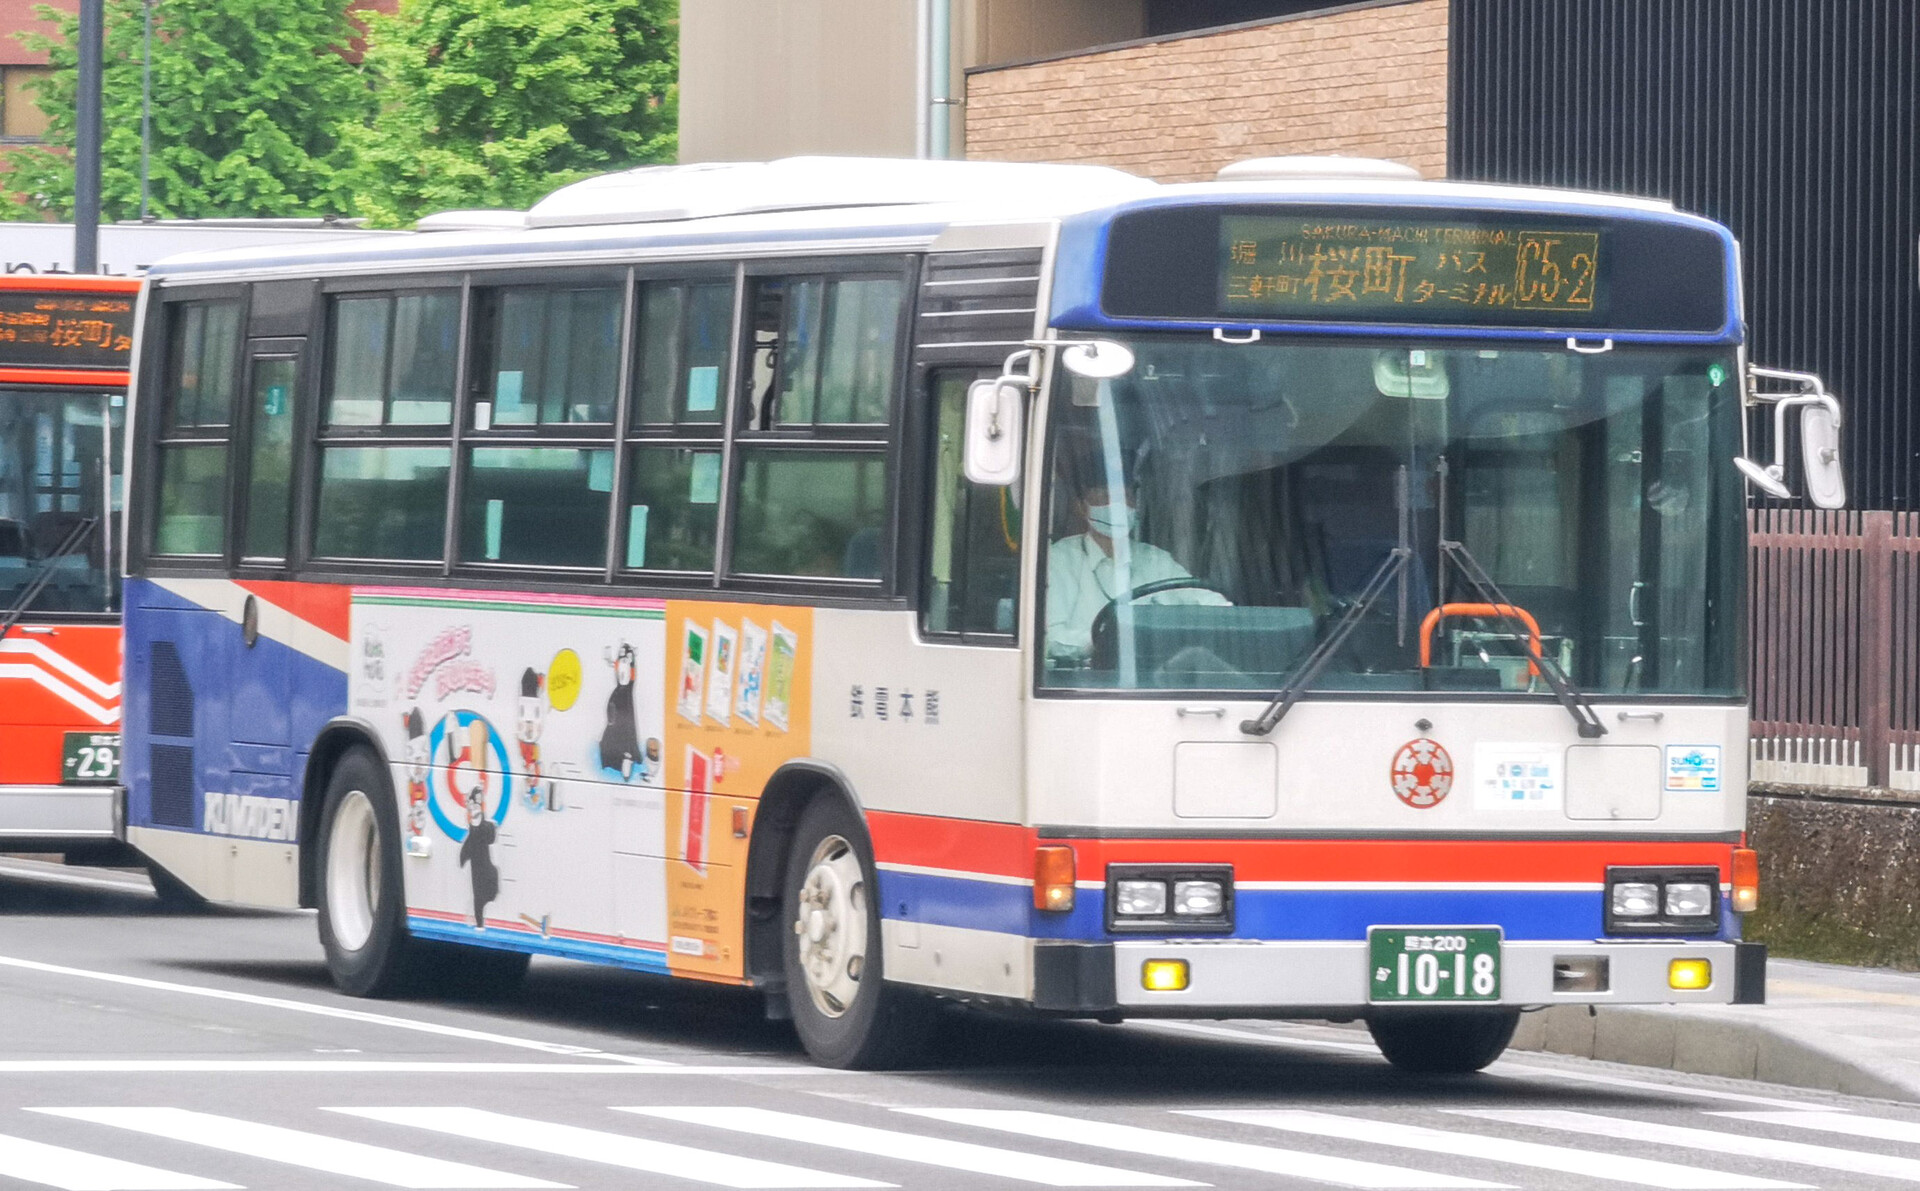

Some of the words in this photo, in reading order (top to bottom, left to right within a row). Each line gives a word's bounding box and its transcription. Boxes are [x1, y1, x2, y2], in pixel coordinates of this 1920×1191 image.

[1304, 242, 1416, 304] 桜町
[1413, 279, 1513, 305] ターミナル
[1397, 953, 1495, 996] 10-18
